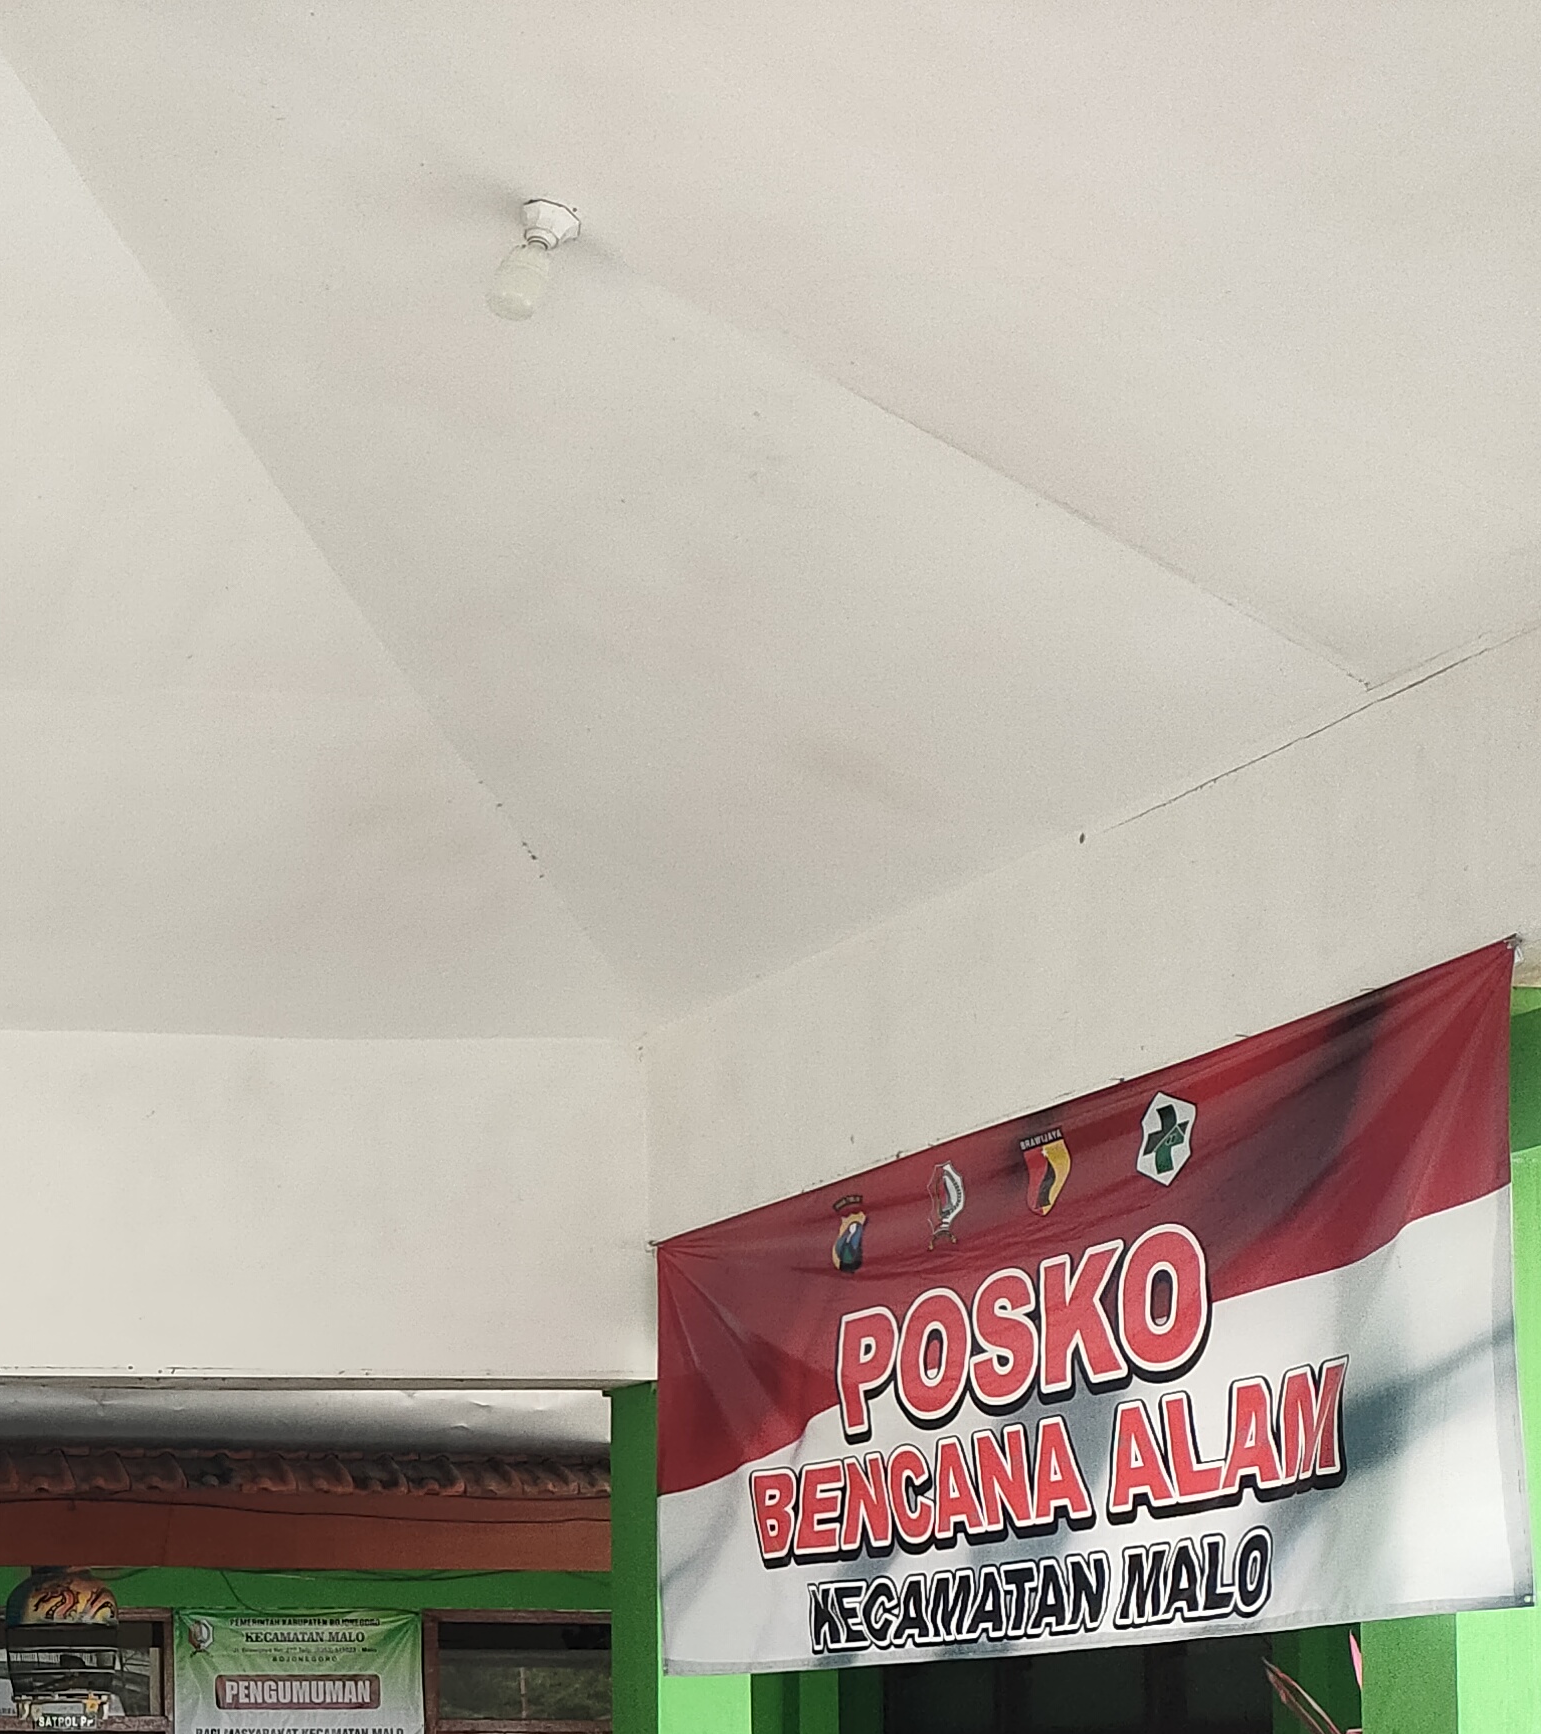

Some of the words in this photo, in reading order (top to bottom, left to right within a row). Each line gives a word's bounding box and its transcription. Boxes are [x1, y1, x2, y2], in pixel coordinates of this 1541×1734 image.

[1020, 1129, 1062, 1150] BRAWIJAYA
[836, 1223, 1211, 1440] POSKO
[751, 1415, 1088, 1561] BENCANA
[1112, 1357, 1348, 1512] ALAM
[809, 1549, 1112, 1653] KECAMATAN
[1118, 1527, 1273, 1626] MALO
[245, 1632, 326, 1643] KECAMATAN
[329, 1632, 365, 1643] MALO
[225, 1680, 371, 1703] PENGUMUMAN
[38, 1716, 78, 1727] SATPOL
